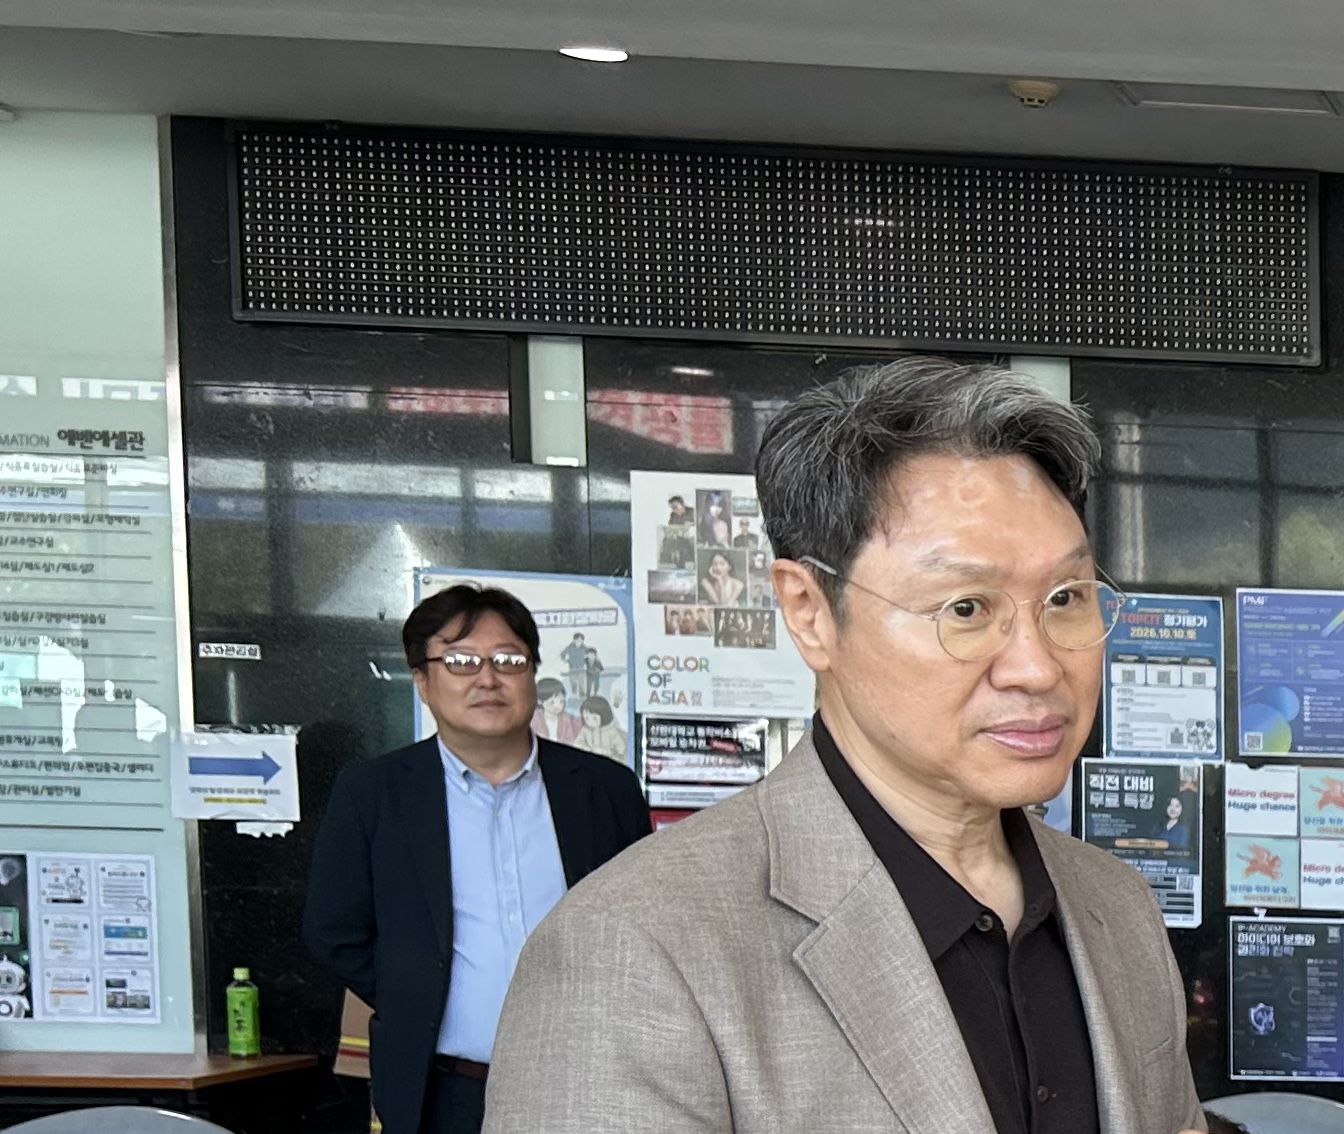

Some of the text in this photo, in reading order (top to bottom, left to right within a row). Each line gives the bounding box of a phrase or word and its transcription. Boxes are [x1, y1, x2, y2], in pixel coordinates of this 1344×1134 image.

[647, 654, 710, 672] COLOR
[647, 672, 673, 688] OF
[648, 689, 689, 706] ASIA
[1123, 775, 1154, 792] 대비
[1227, 788, 1295, 801] Micro degree
[1227, 800, 1296, 812] Huge chance
[1303, 863, 1332, 873] Micro
[1302, 876, 1332, 887] Huge
